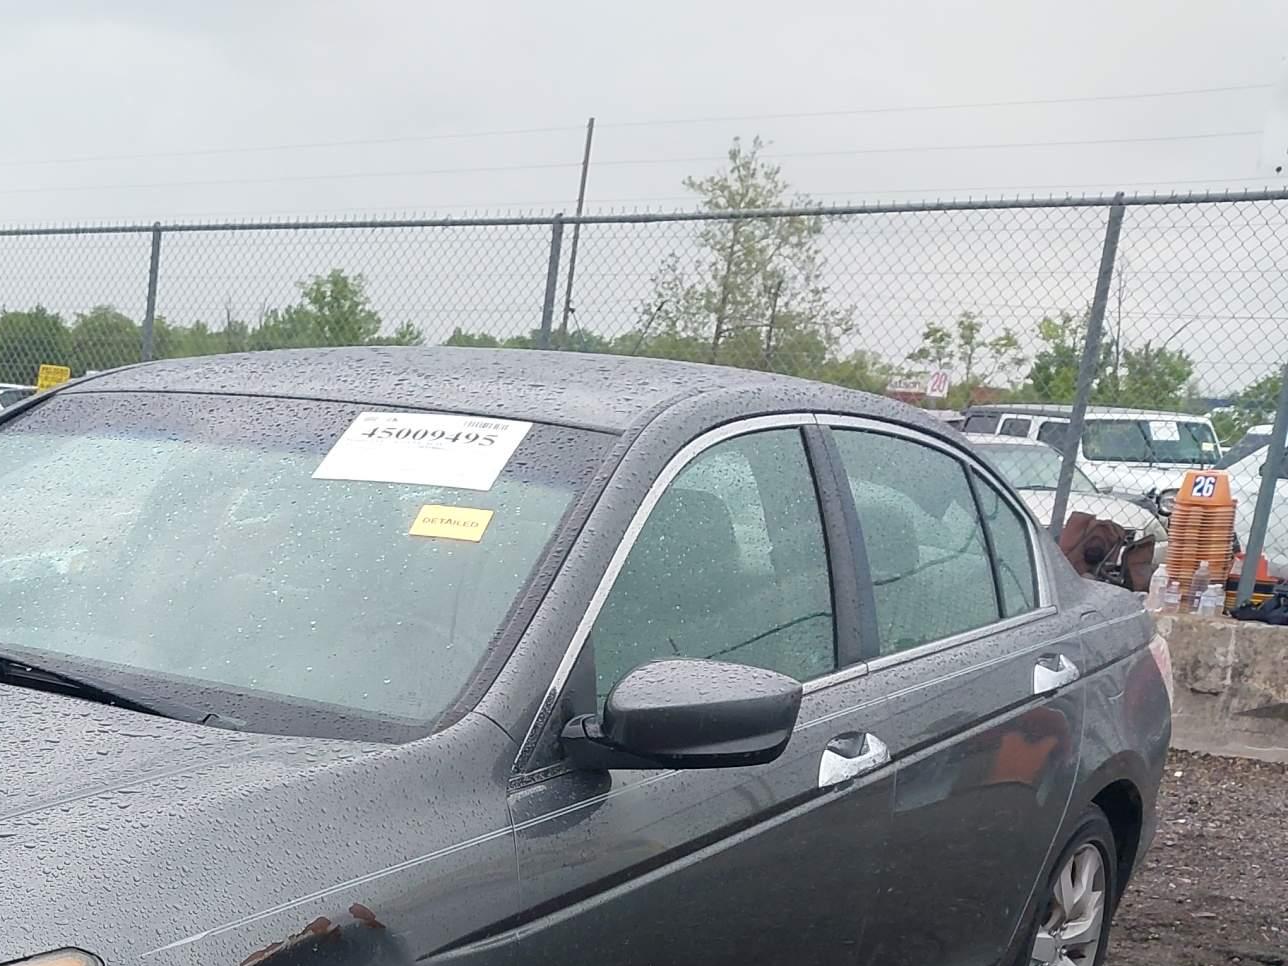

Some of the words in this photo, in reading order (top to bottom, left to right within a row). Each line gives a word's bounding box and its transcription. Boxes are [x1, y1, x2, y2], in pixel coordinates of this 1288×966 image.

[361, 426, 499, 447] 45009495
[1192, 475, 1216, 497] 26
[422, 517, 480, 528] DETAILED
